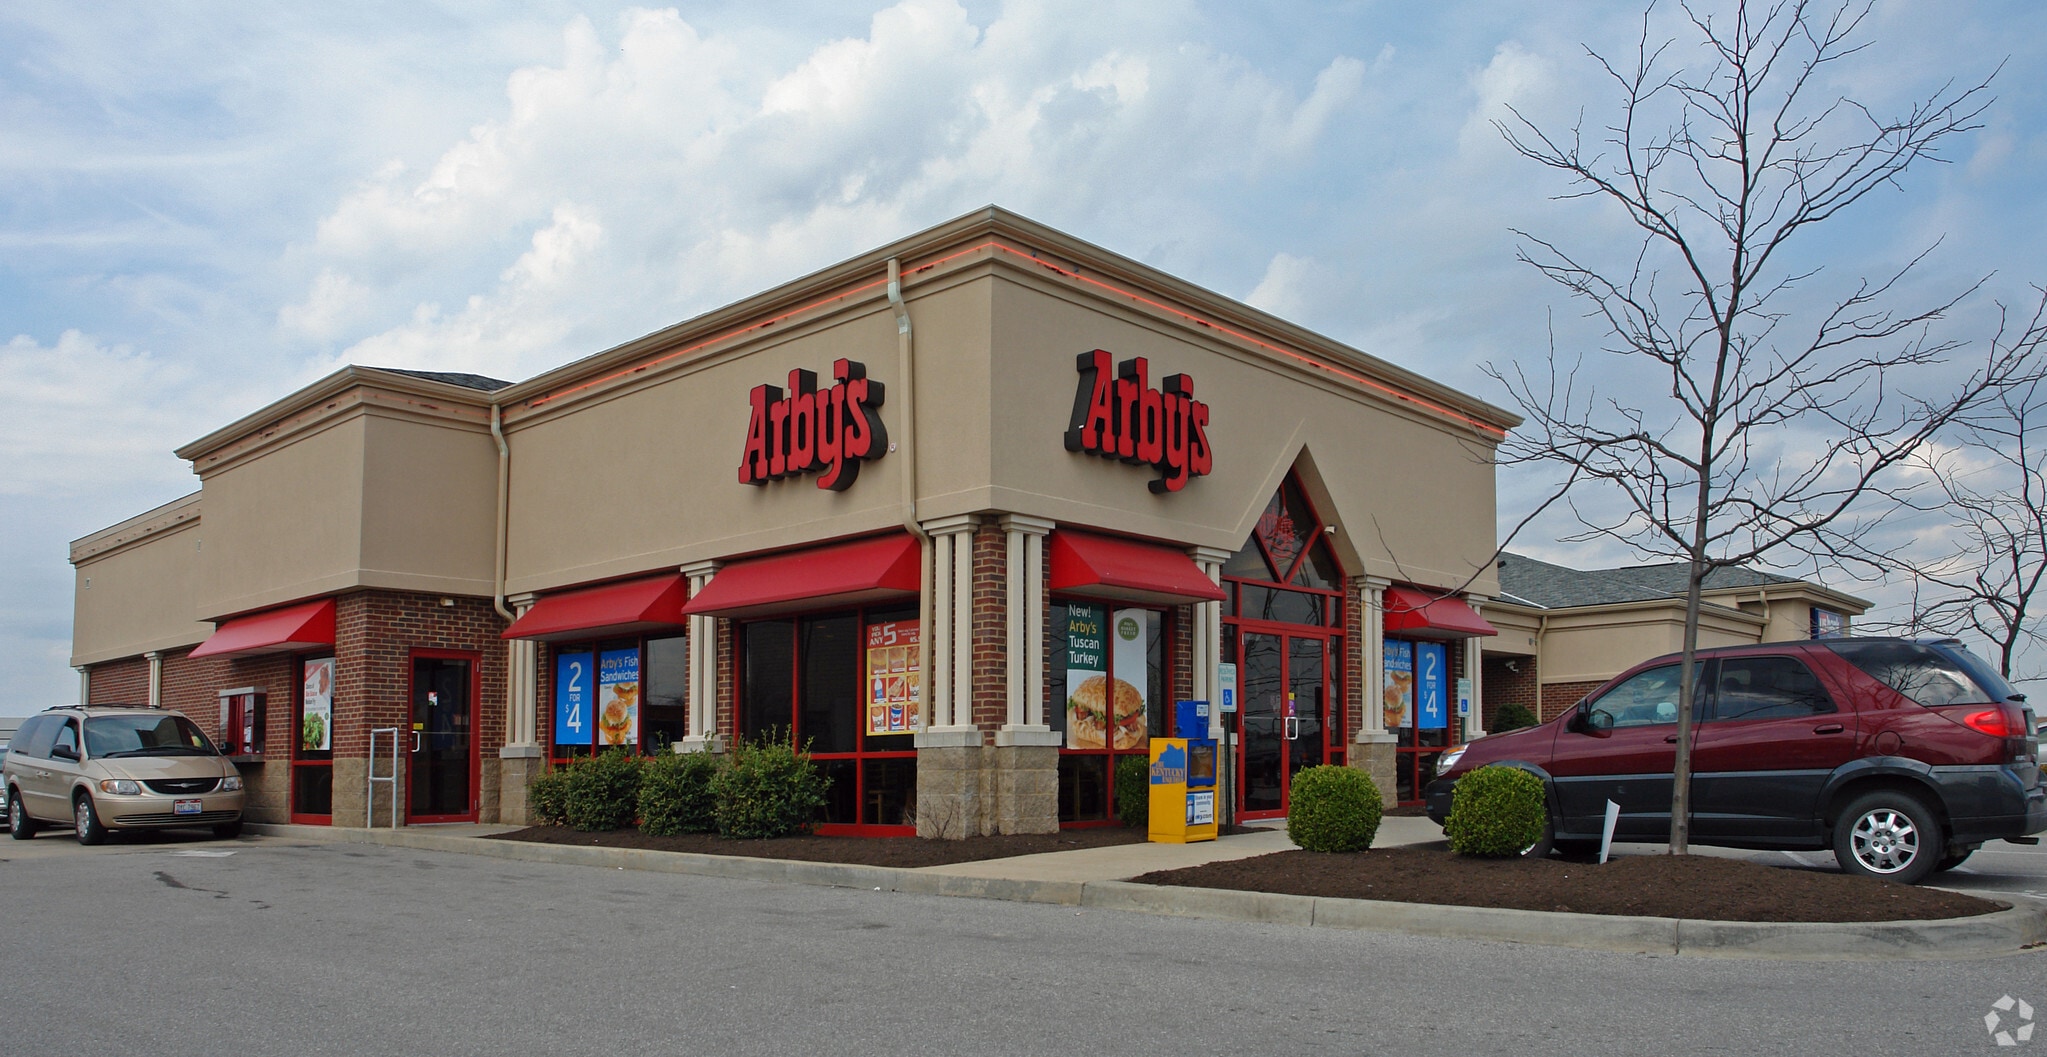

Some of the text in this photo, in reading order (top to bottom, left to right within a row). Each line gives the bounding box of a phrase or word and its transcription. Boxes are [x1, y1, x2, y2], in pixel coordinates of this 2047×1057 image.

[737, 357, 870, 491] Arby's
[1081, 348, 1213, 493] Arby's
[1069, 604, 1091, 618] New!
[870, 623, 896, 646] ANY 5
[1069, 619, 1097, 636] Arby's
[1069, 635, 1100, 650] Tuscan
[1069, 650, 1099, 668] Turkey
[1400, 647, 1410, 658] Fish
[601, 656, 638, 670] Arby's Fish
[1425, 652, 1437, 680] 2
[568, 661, 582, 692] 2
[600, 670, 638, 682] Sandwiches
[1426, 681, 1437, 689] FOR
[569, 693, 581, 702] FOR
[565, 703, 582, 733] $4
[1151, 767, 1184, 777] KENTUCKY
